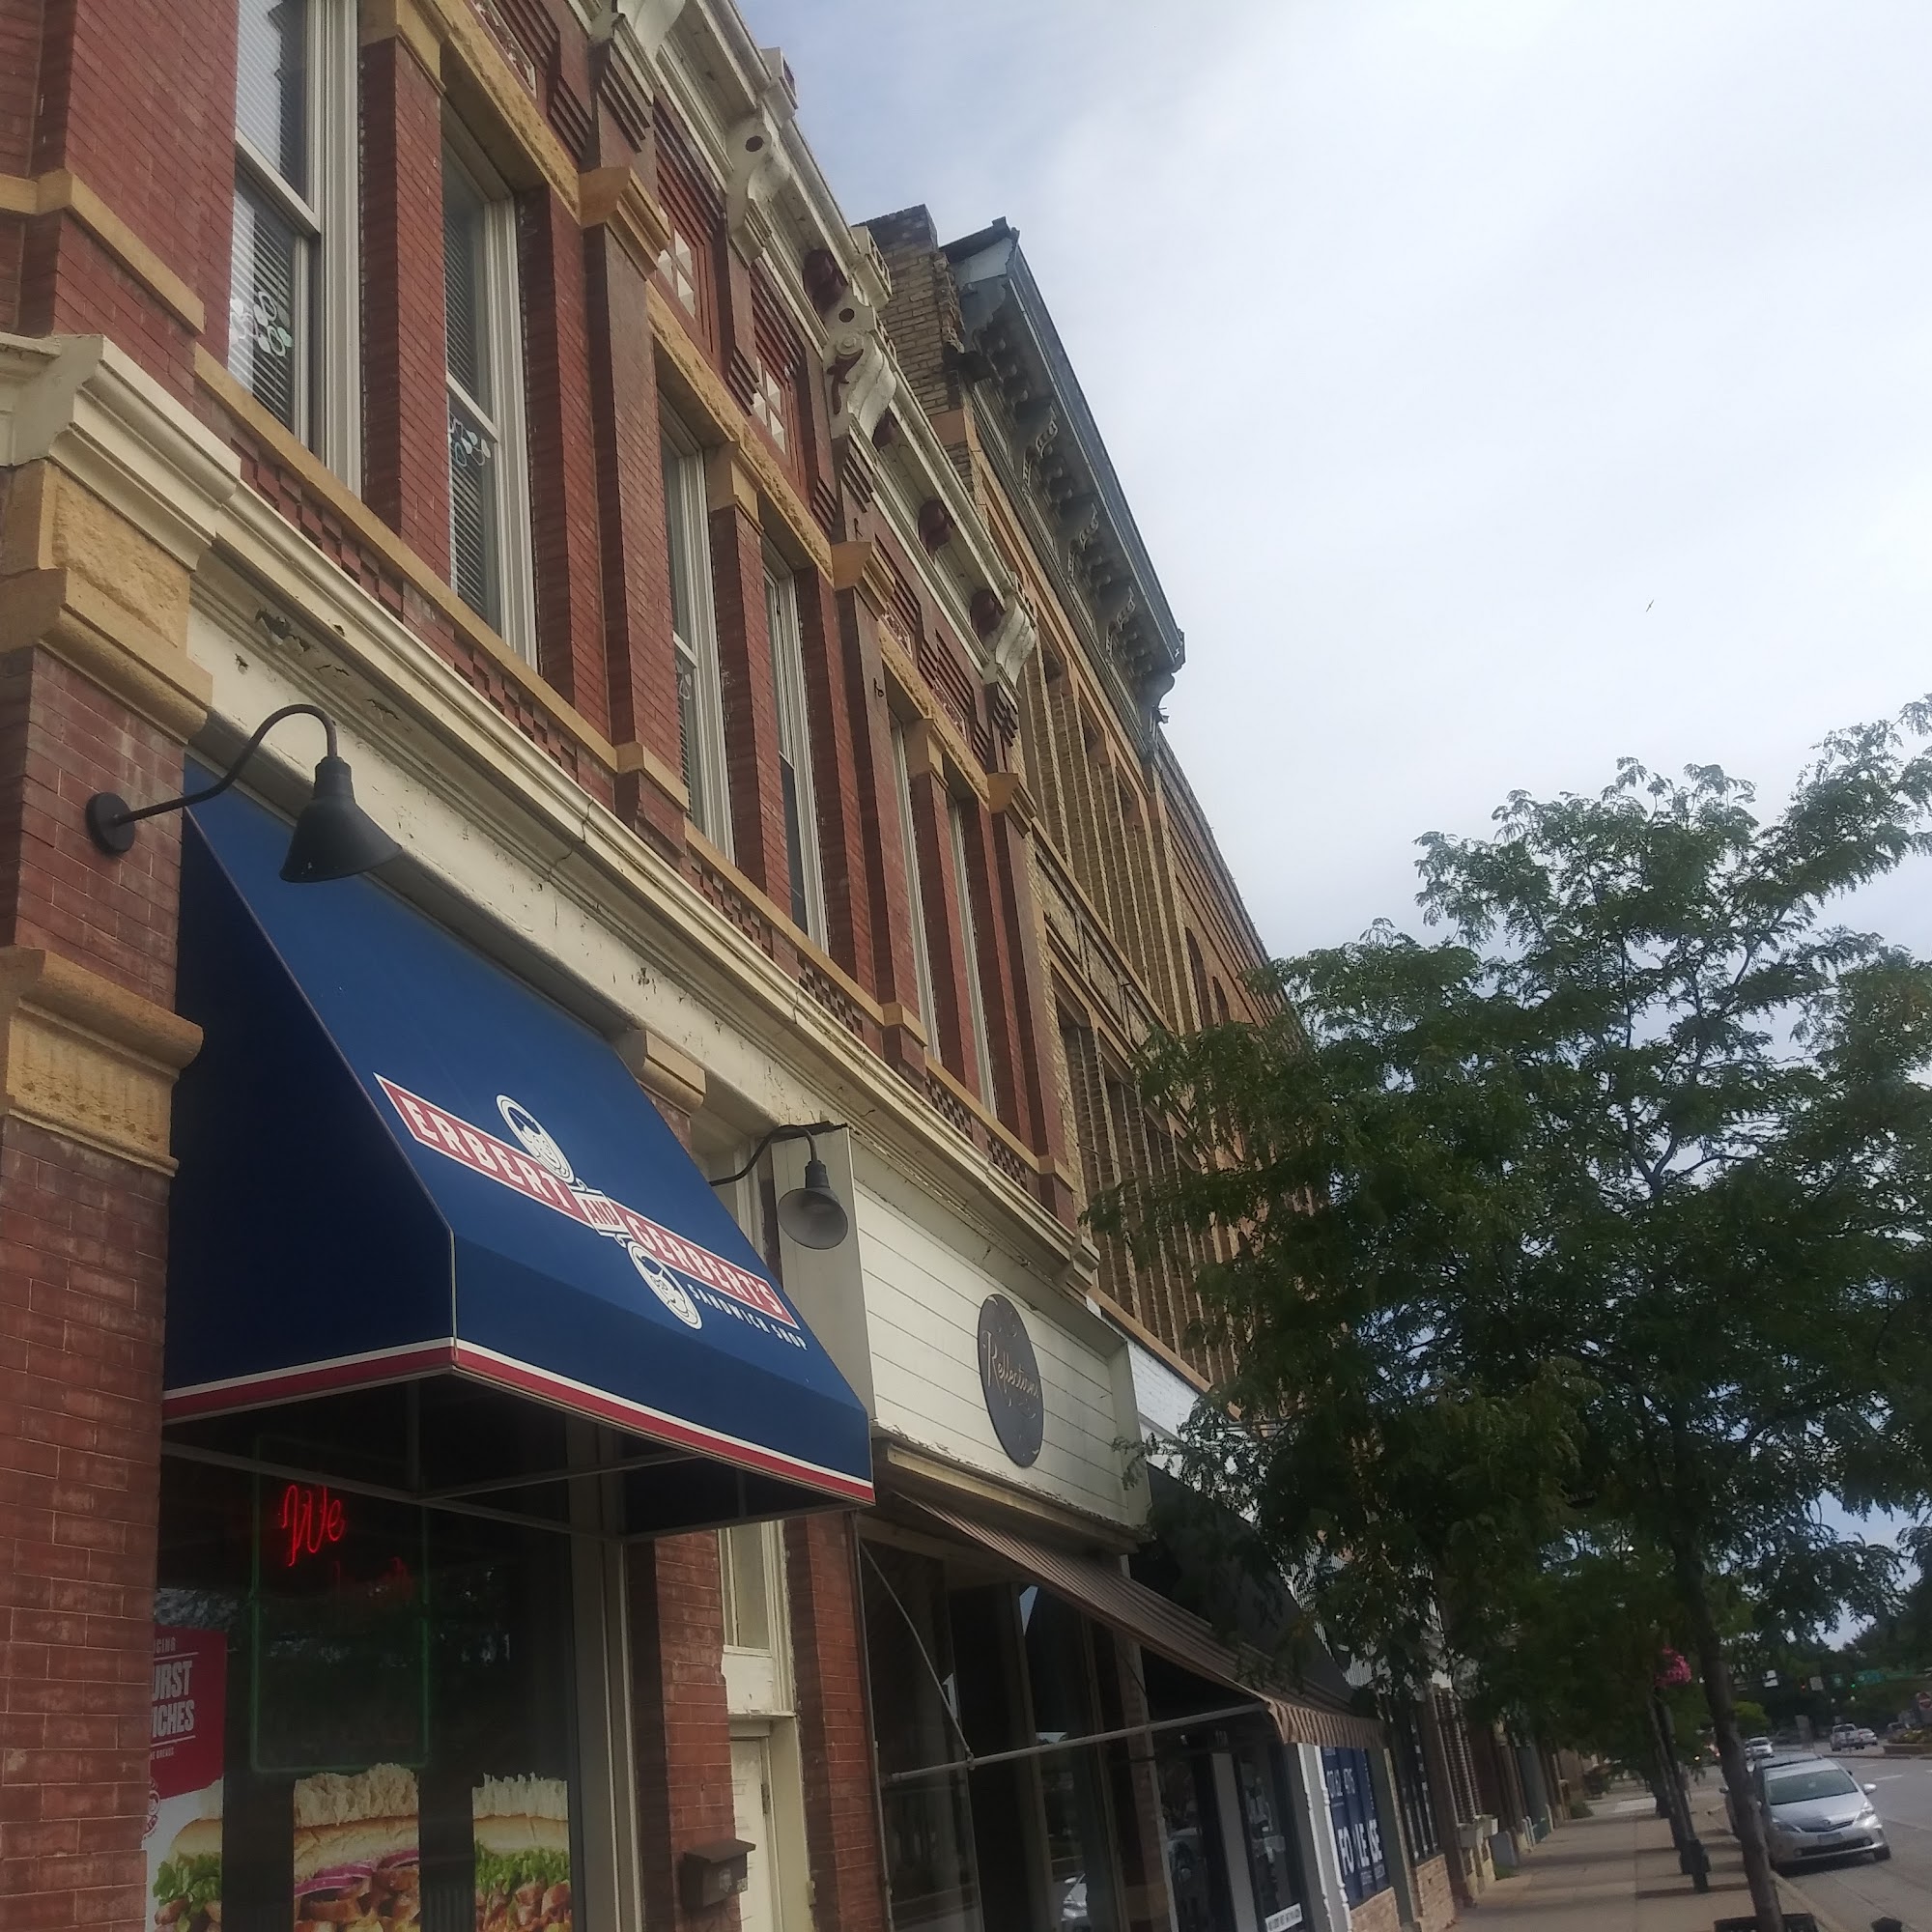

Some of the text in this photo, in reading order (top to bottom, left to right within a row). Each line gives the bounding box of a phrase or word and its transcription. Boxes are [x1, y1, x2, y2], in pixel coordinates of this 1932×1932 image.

[398, 1094, 783, 1316] ERBERT AND GERBERT'S
[687, 1283, 809, 1351] SANDWICH SHOP
[281, 1483, 347, 1568] We
